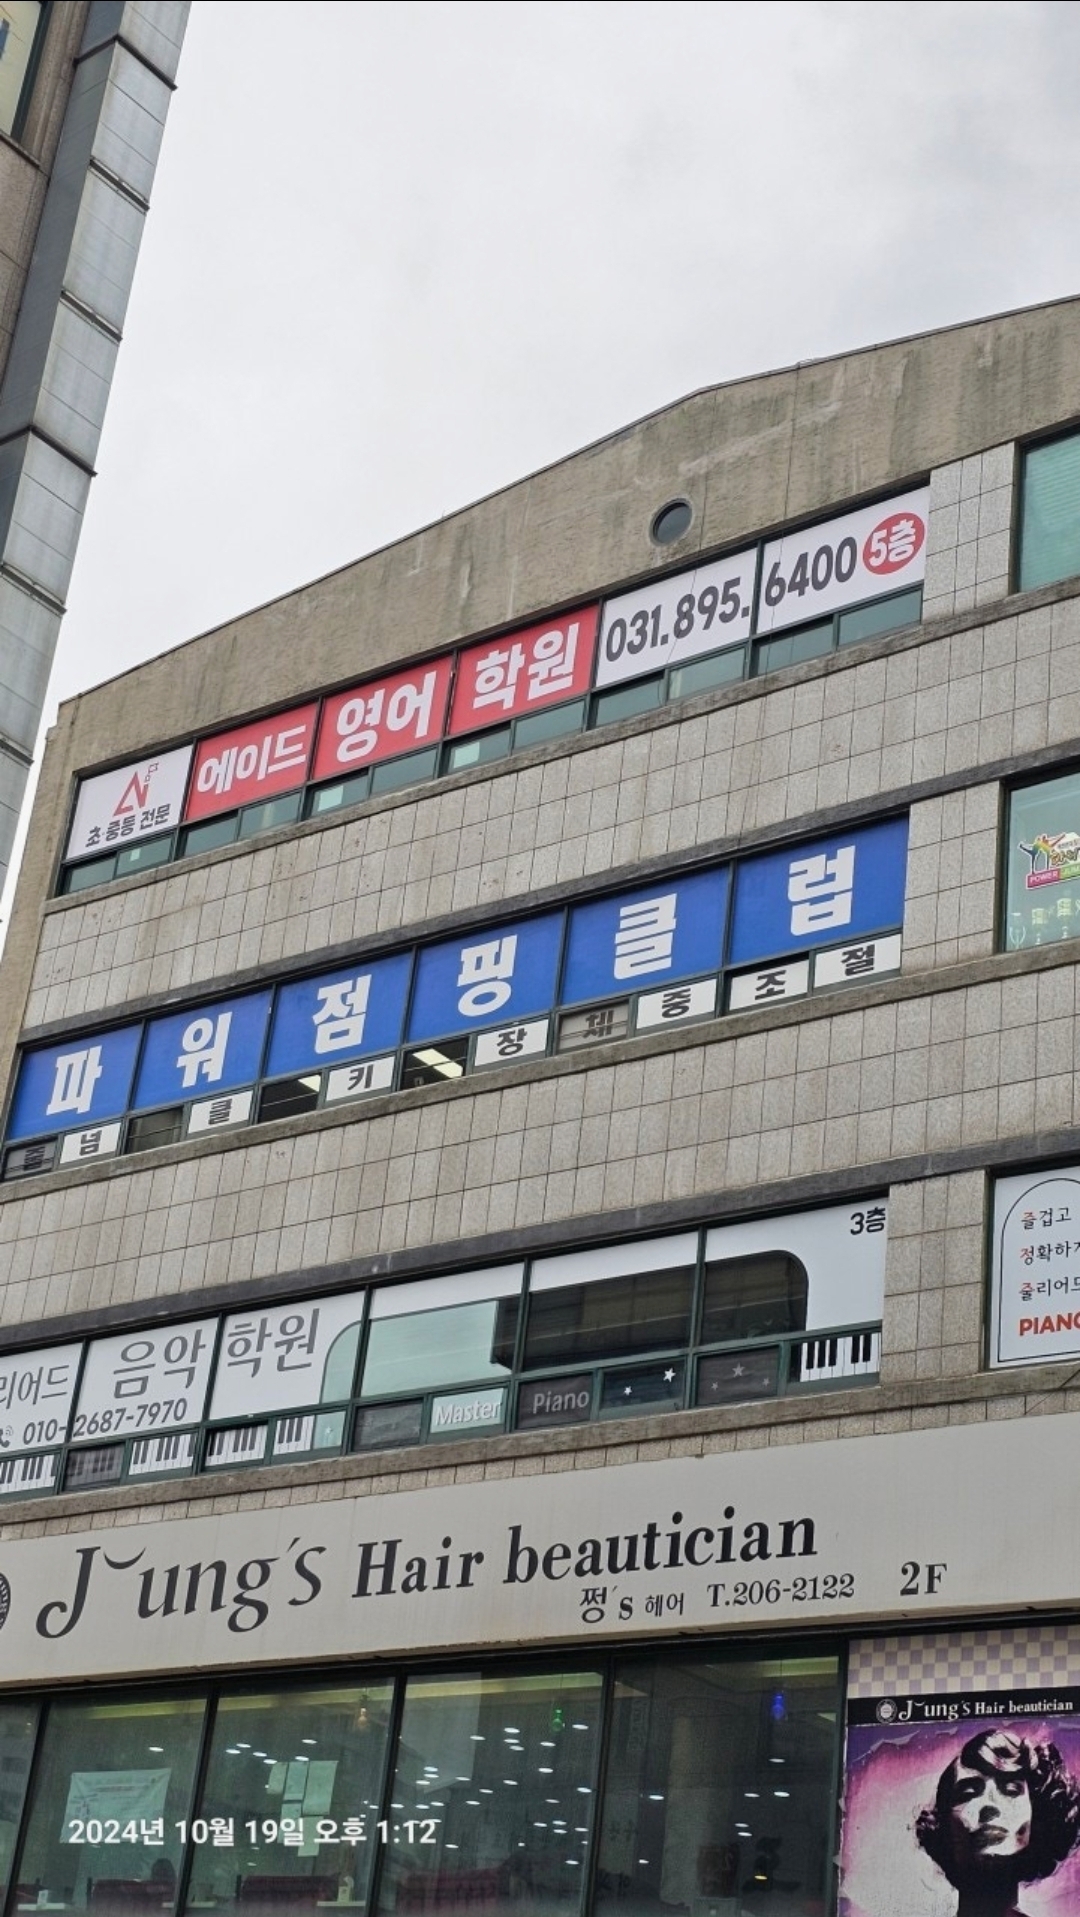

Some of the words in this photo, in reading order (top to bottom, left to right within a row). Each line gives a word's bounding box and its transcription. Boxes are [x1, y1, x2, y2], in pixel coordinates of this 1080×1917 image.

[606, 536, 857, 662] 031.895.6400
[868, 519, 922, 567] 5층
[198, 724, 307, 793] 에이드
[335, 671, 436, 763] 영어
[472, 623, 578, 709] 학원
[140, 804, 171, 830] 전문
[850, 1206, 886, 1235] 3층
[1021, 1207, 1072, 1230] 즐겁고
[113, 1328, 206, 1399] 음악
[227, 1308, 320, 1378] 학원
[23, 1398, 187, 1446] 010-2687-7970
[433, 1398, 502, 1426] Master
[532, 1391, 590, 1415] Piano
[351, 1535, 485, 1598] Hair
[502, 1506, 818, 1584] beautician
[646, 1592, 685, 1617] 헤어
[707, 1573, 855, 1608] T.206-2122
[899, 1561, 948, 1597] 2F
[974, 1702, 1005, 1716] Hair
[1008, 1699, 1074, 1714] beautician
